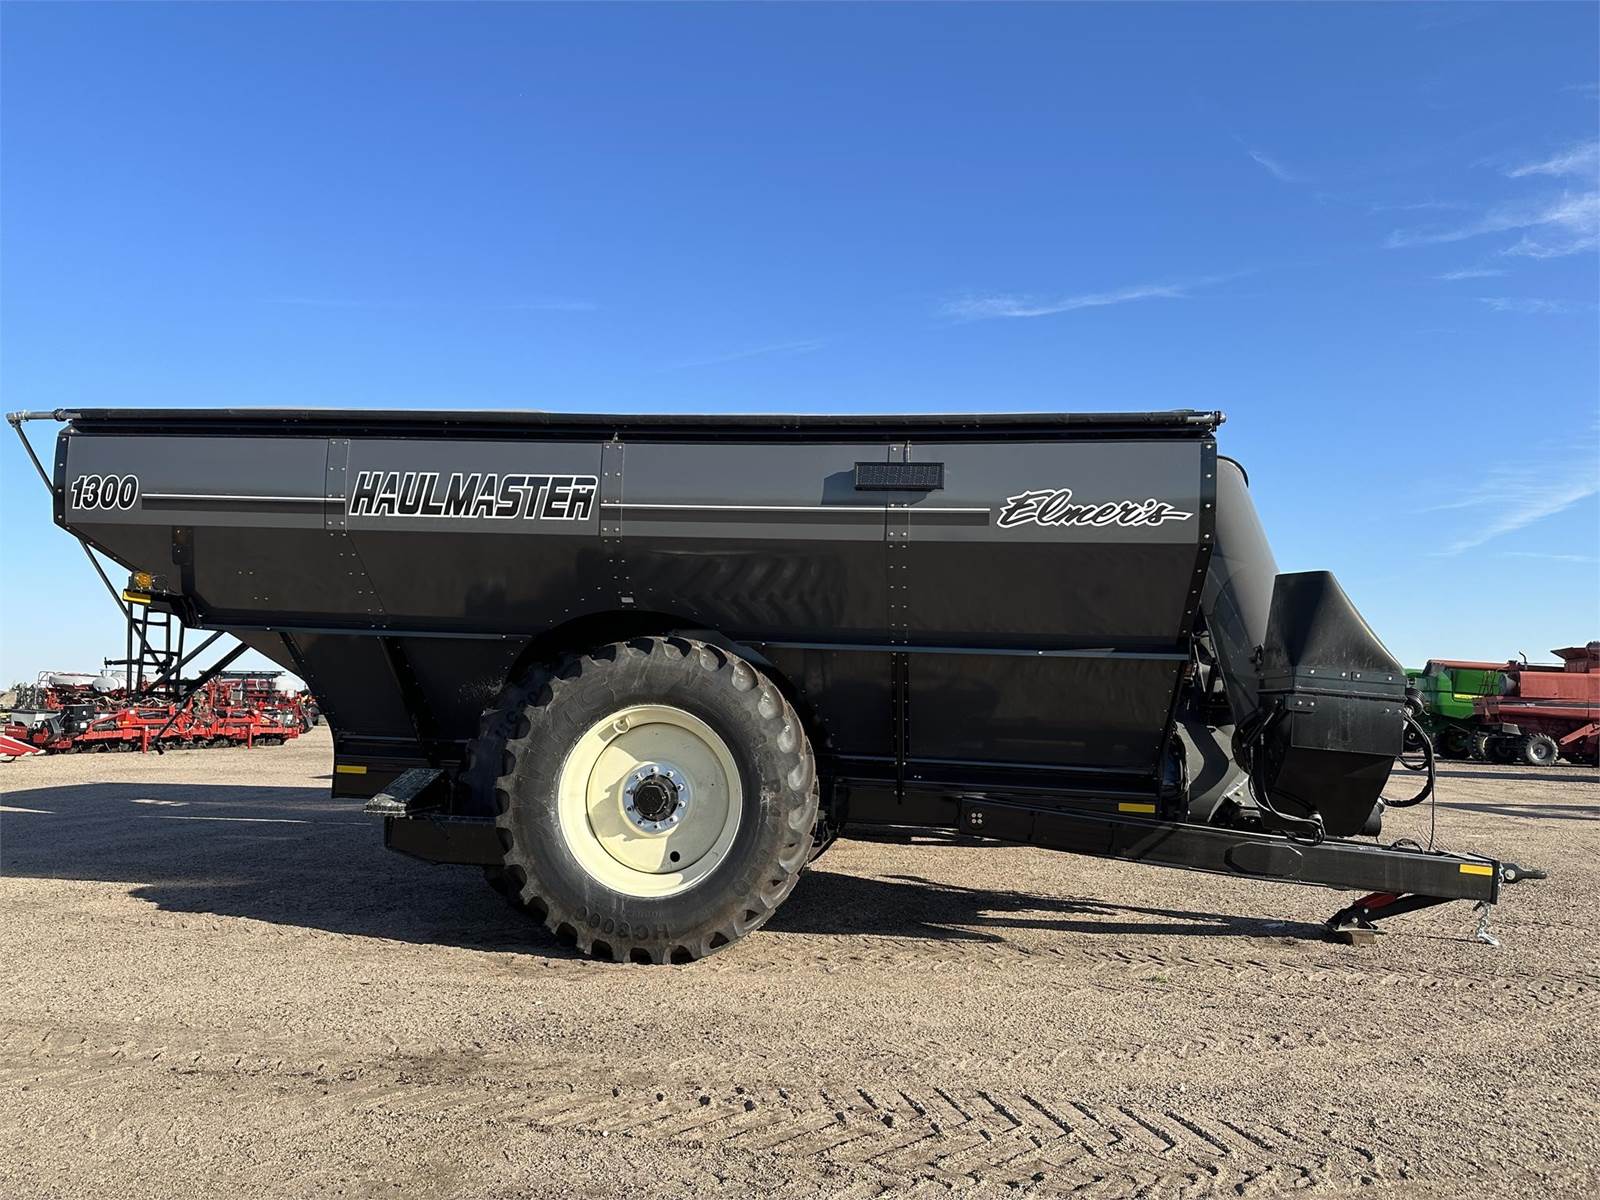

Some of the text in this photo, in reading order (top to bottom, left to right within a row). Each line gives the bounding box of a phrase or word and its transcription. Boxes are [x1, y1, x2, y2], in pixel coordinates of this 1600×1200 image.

[71, 474, 139, 510] 1300
[349, 471, 598, 520] HAULMASTER
[997, 488, 1194, 528] Elmer's
